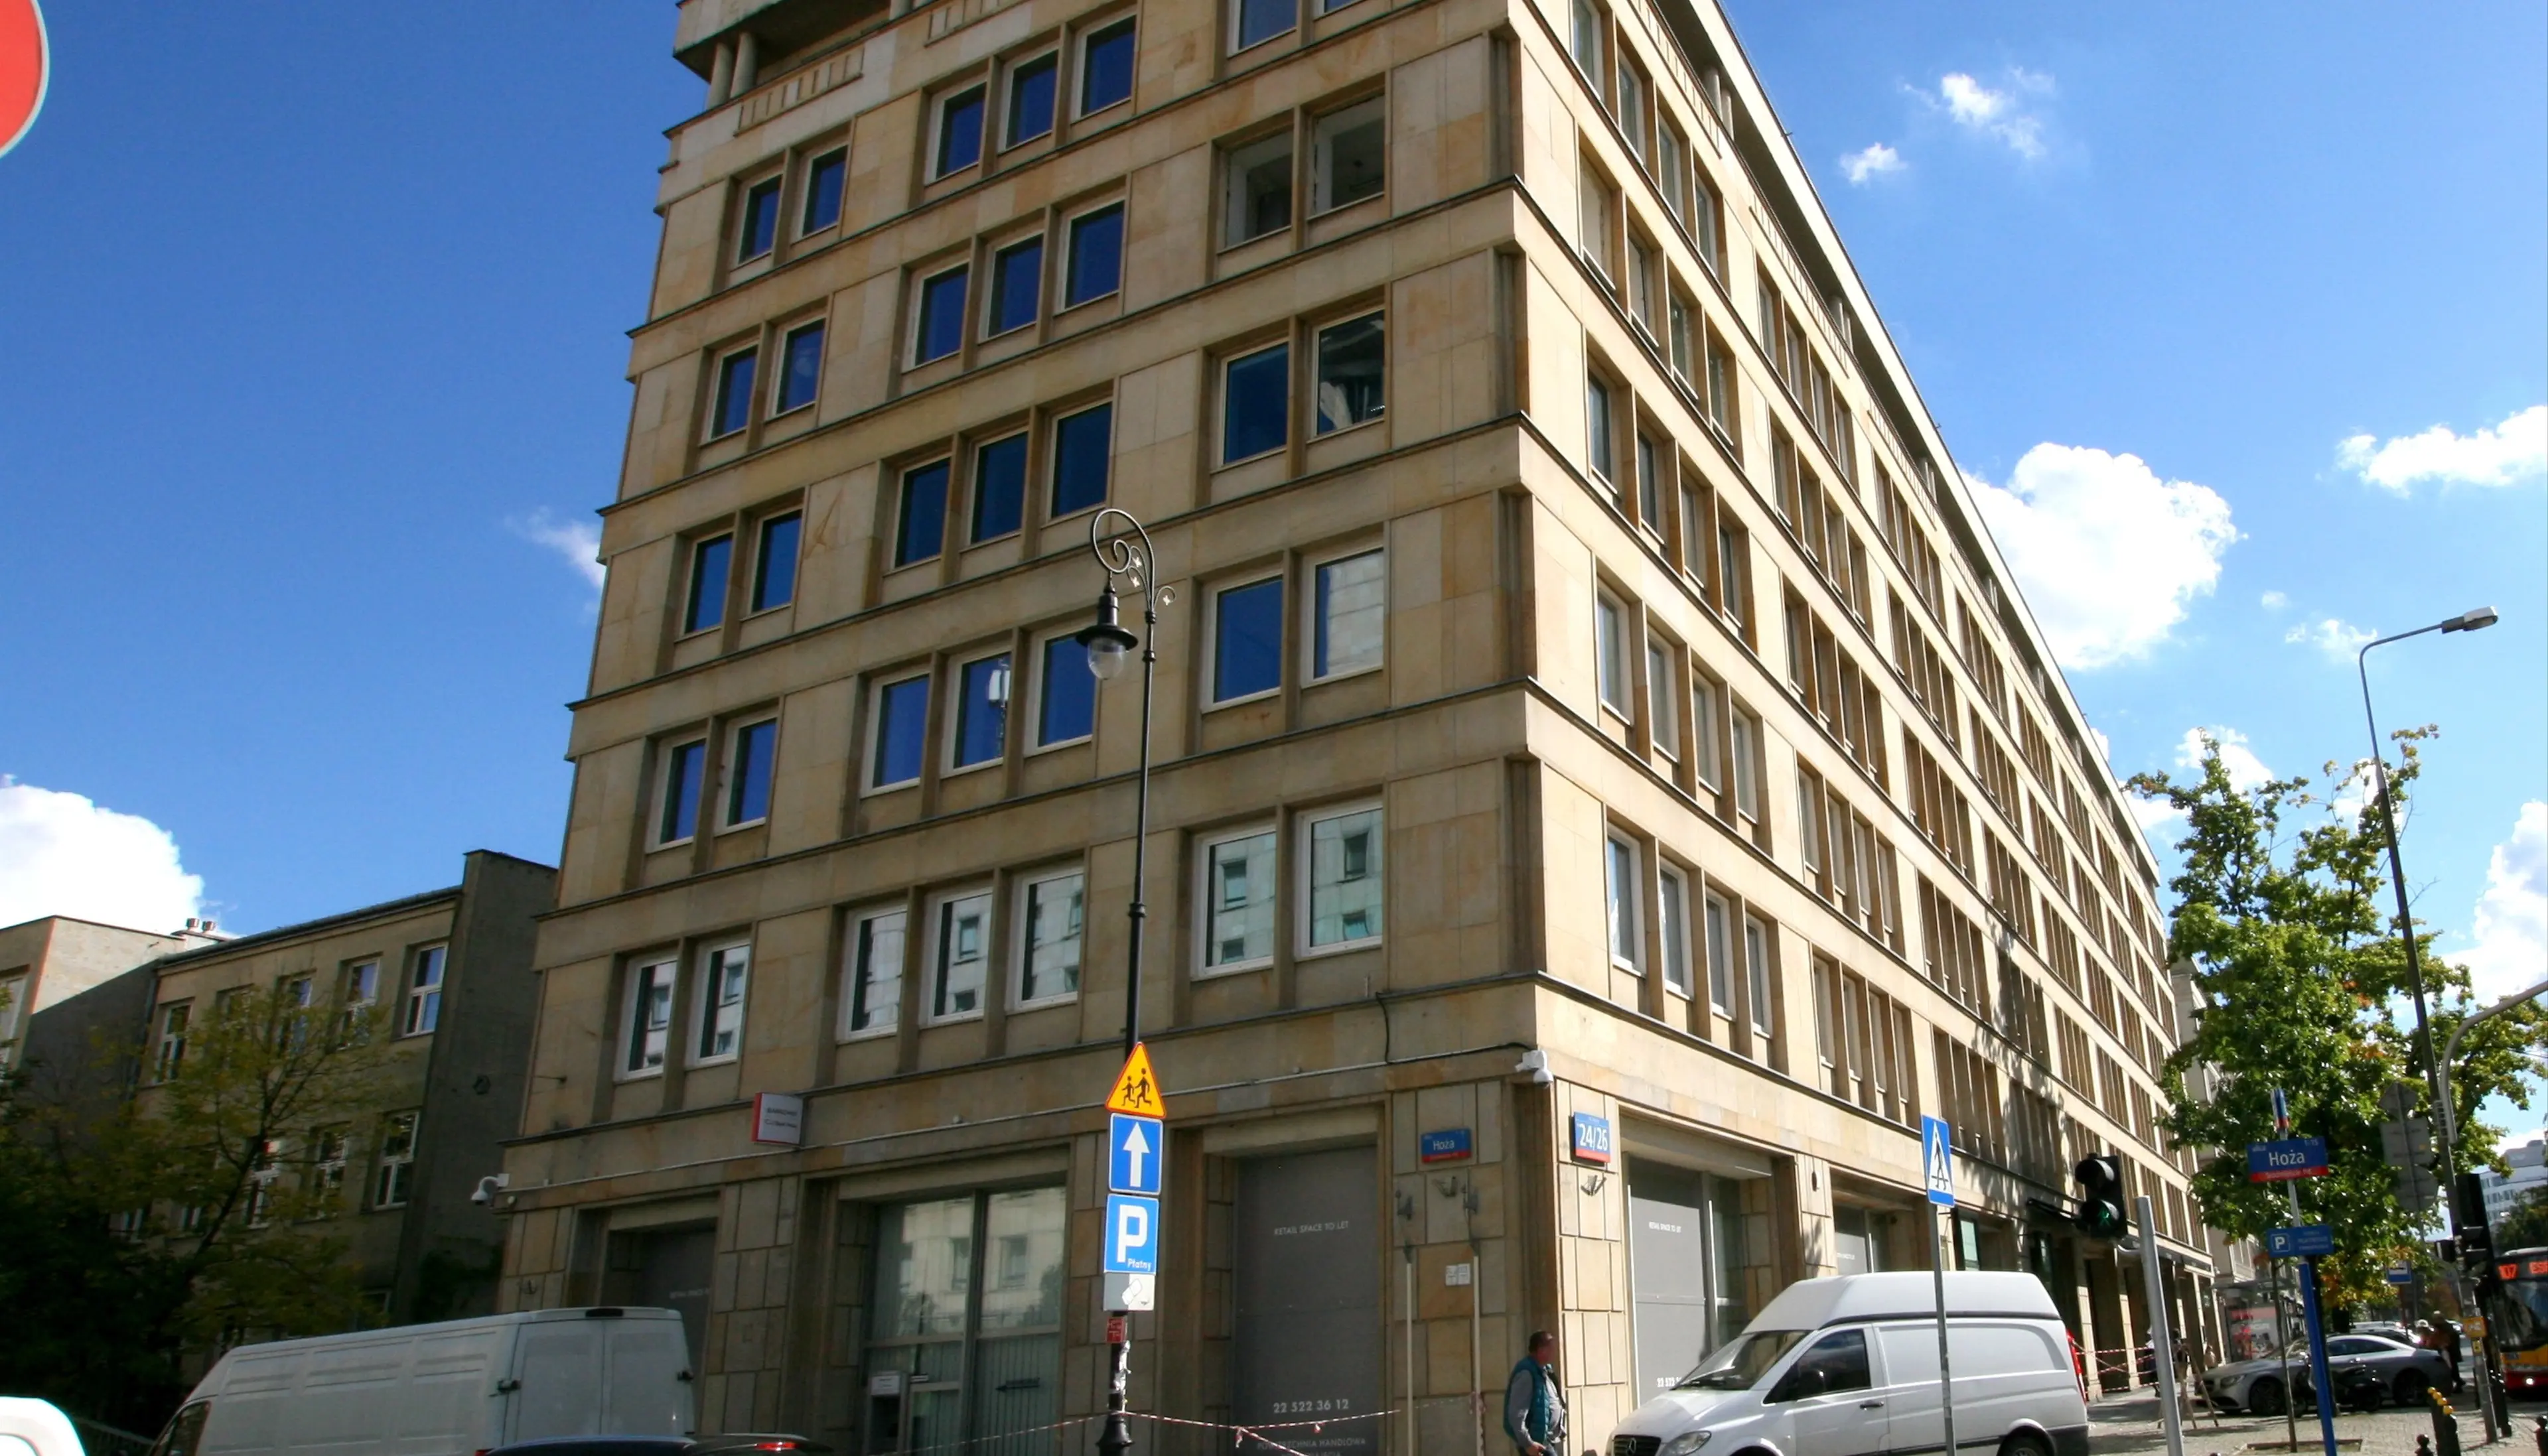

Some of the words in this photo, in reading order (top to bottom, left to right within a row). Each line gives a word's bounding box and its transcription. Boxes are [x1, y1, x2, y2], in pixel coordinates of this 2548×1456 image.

[1578, 1122, 1608, 1151] 24/26
[1433, 1139, 1455, 1151] Hoża
[2268, 1149, 2306, 1167] Hoża
[1117, 1203, 1149, 1263] P
[1299, 1224, 1322, 1233] SPACE
[1324, 1223, 1335, 1231] TO
[1336, 1221, 1349, 1230] LET
[2275, 1236, 2285, 1250] P
[1273, 1402, 1287, 1414] 22
[1291, 1401, 1312, 1412] 522
[1316, 1400, 1331, 1411] 36
[1336, 1399, 1349, 1410] 12
